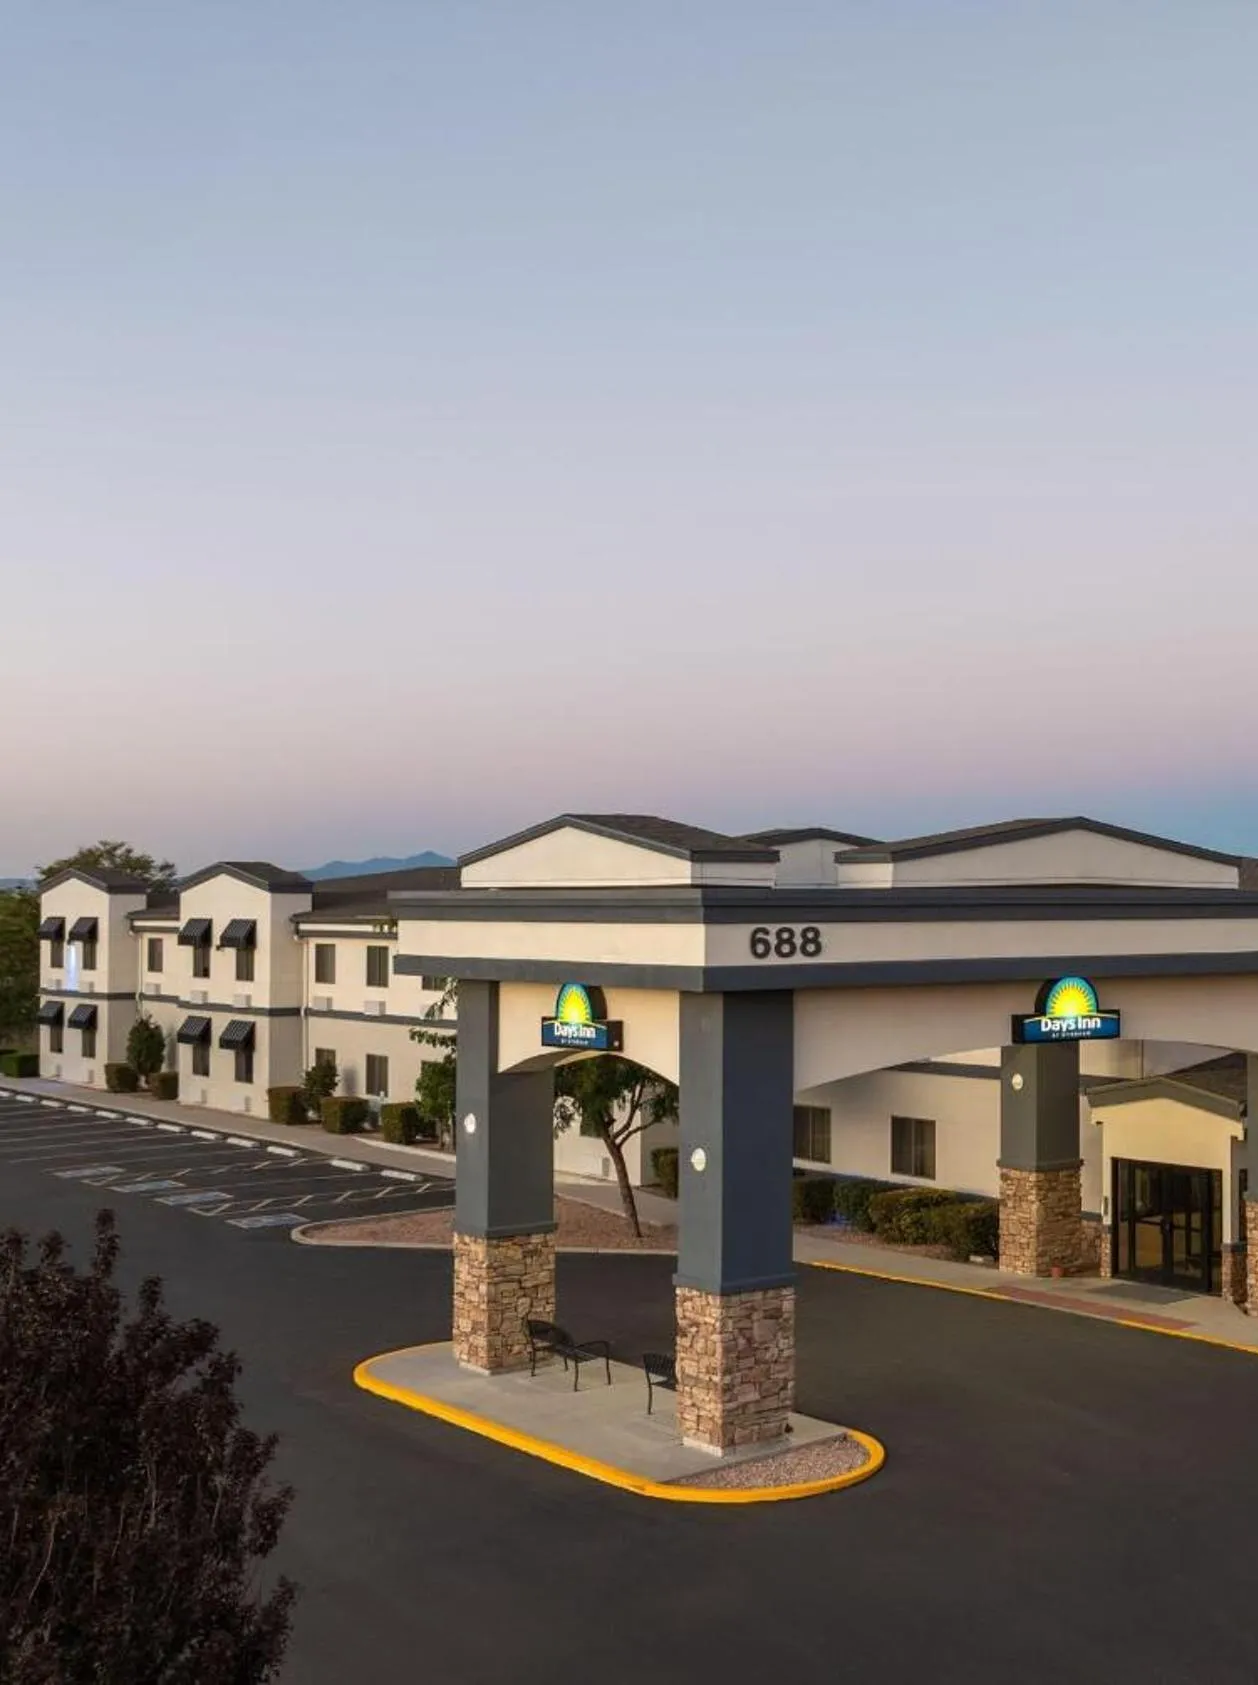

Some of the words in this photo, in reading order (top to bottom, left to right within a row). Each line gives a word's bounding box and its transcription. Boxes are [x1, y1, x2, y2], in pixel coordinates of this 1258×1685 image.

[749, 926, 822, 960] 688
[554, 1022, 578, 1038] Days
[579, 1024, 596, 1038] Inn
[1040, 1018, 1076, 1032] Days
[1077, 1016, 1101, 1029] Inn
